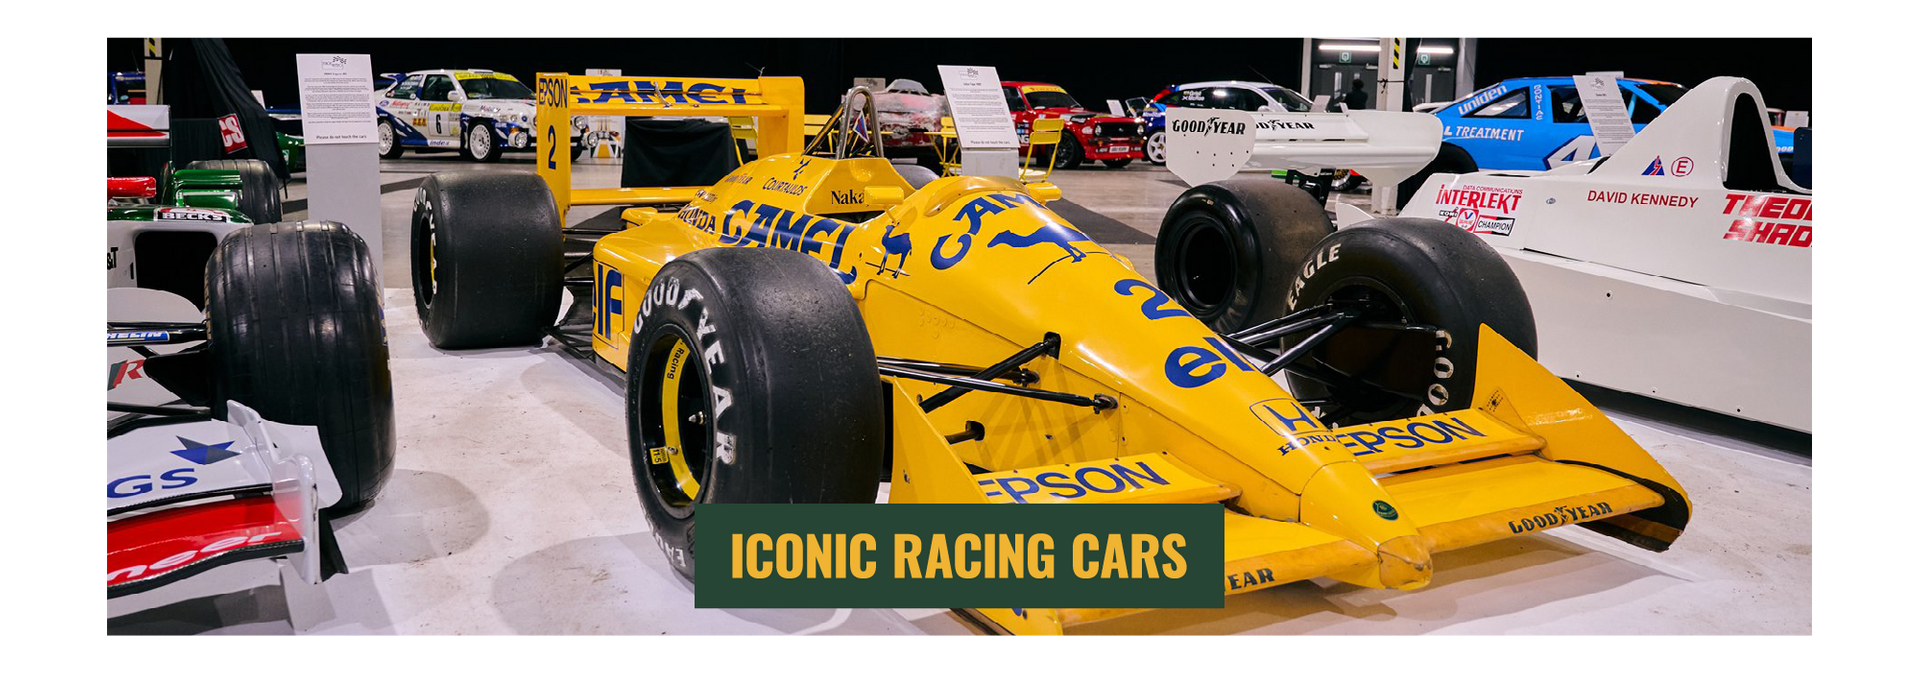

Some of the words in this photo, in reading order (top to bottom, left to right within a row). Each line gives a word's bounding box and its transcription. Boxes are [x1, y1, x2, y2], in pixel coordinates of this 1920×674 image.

[538, 77, 568, 109] EPSON
[1457, 84, 1508, 116] uniden
[435, 113, 443, 134] 6
[1455, 125, 1525, 142] TREATMENT
[547, 124, 557, 171] 2
[762, 177, 808, 196] COURTAULDS
[831, 189, 868, 207] Naka
[1587, 190, 1628, 204] DAVID
[1631, 193, 1699, 209] KENNEDY
[677, 204, 716, 234] HONDA
[1477, 220, 1512, 232] CHAMPION
[718, 200, 858, 285] CAMEL
[1287, 243, 1342, 311] EAGLE
[1113, 278, 1193, 321] 2
[666, 346, 685, 380] Racing
[1226, 567, 1276, 592] EAR
